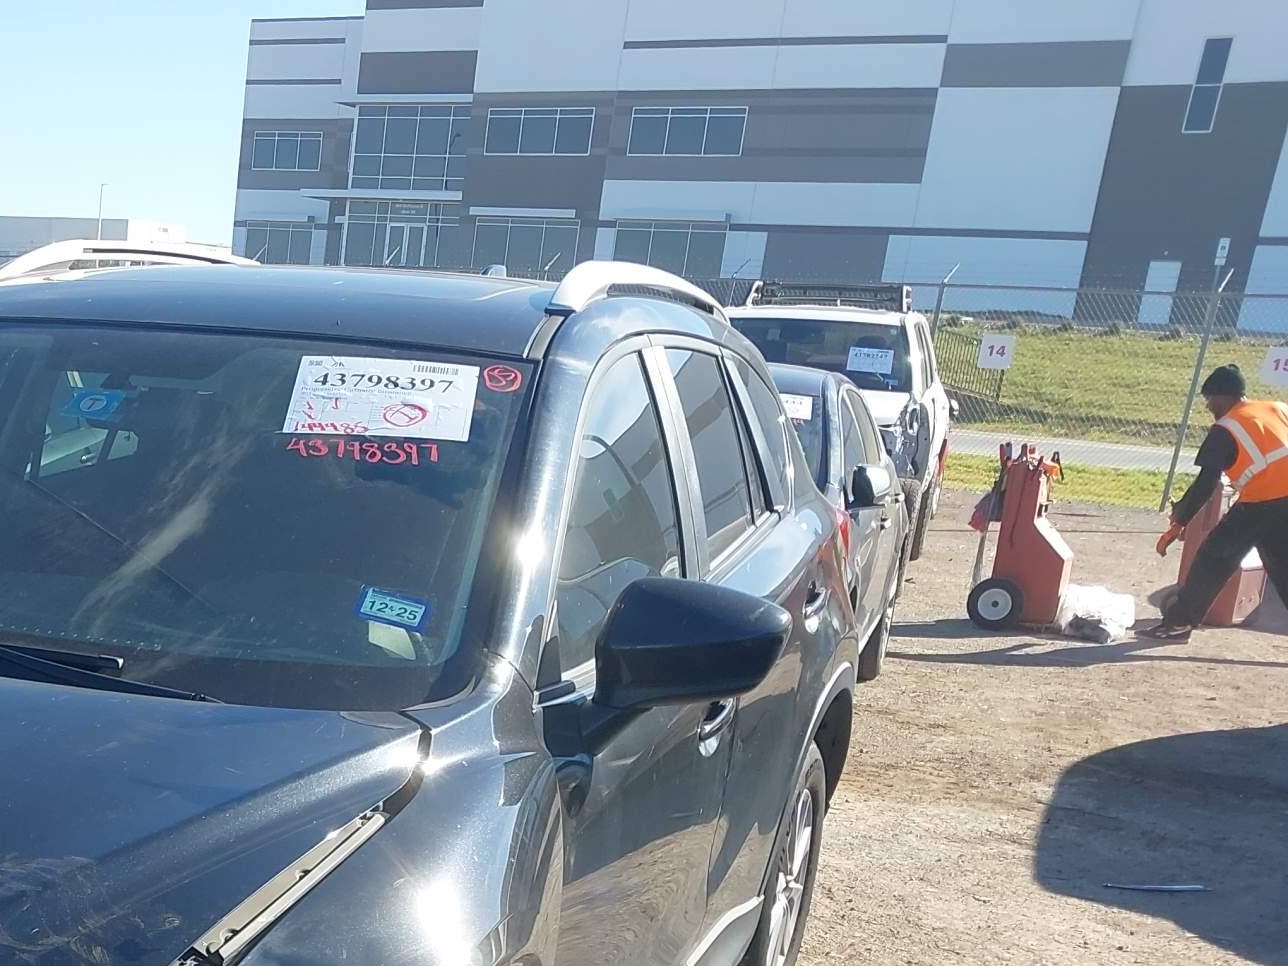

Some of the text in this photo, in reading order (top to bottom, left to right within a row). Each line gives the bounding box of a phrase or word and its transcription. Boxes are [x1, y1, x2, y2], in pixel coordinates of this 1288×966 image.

[988, 344, 1007, 358] 14
[312, 372, 454, 393] 43798397
[285, 437, 439, 466] 43798397
